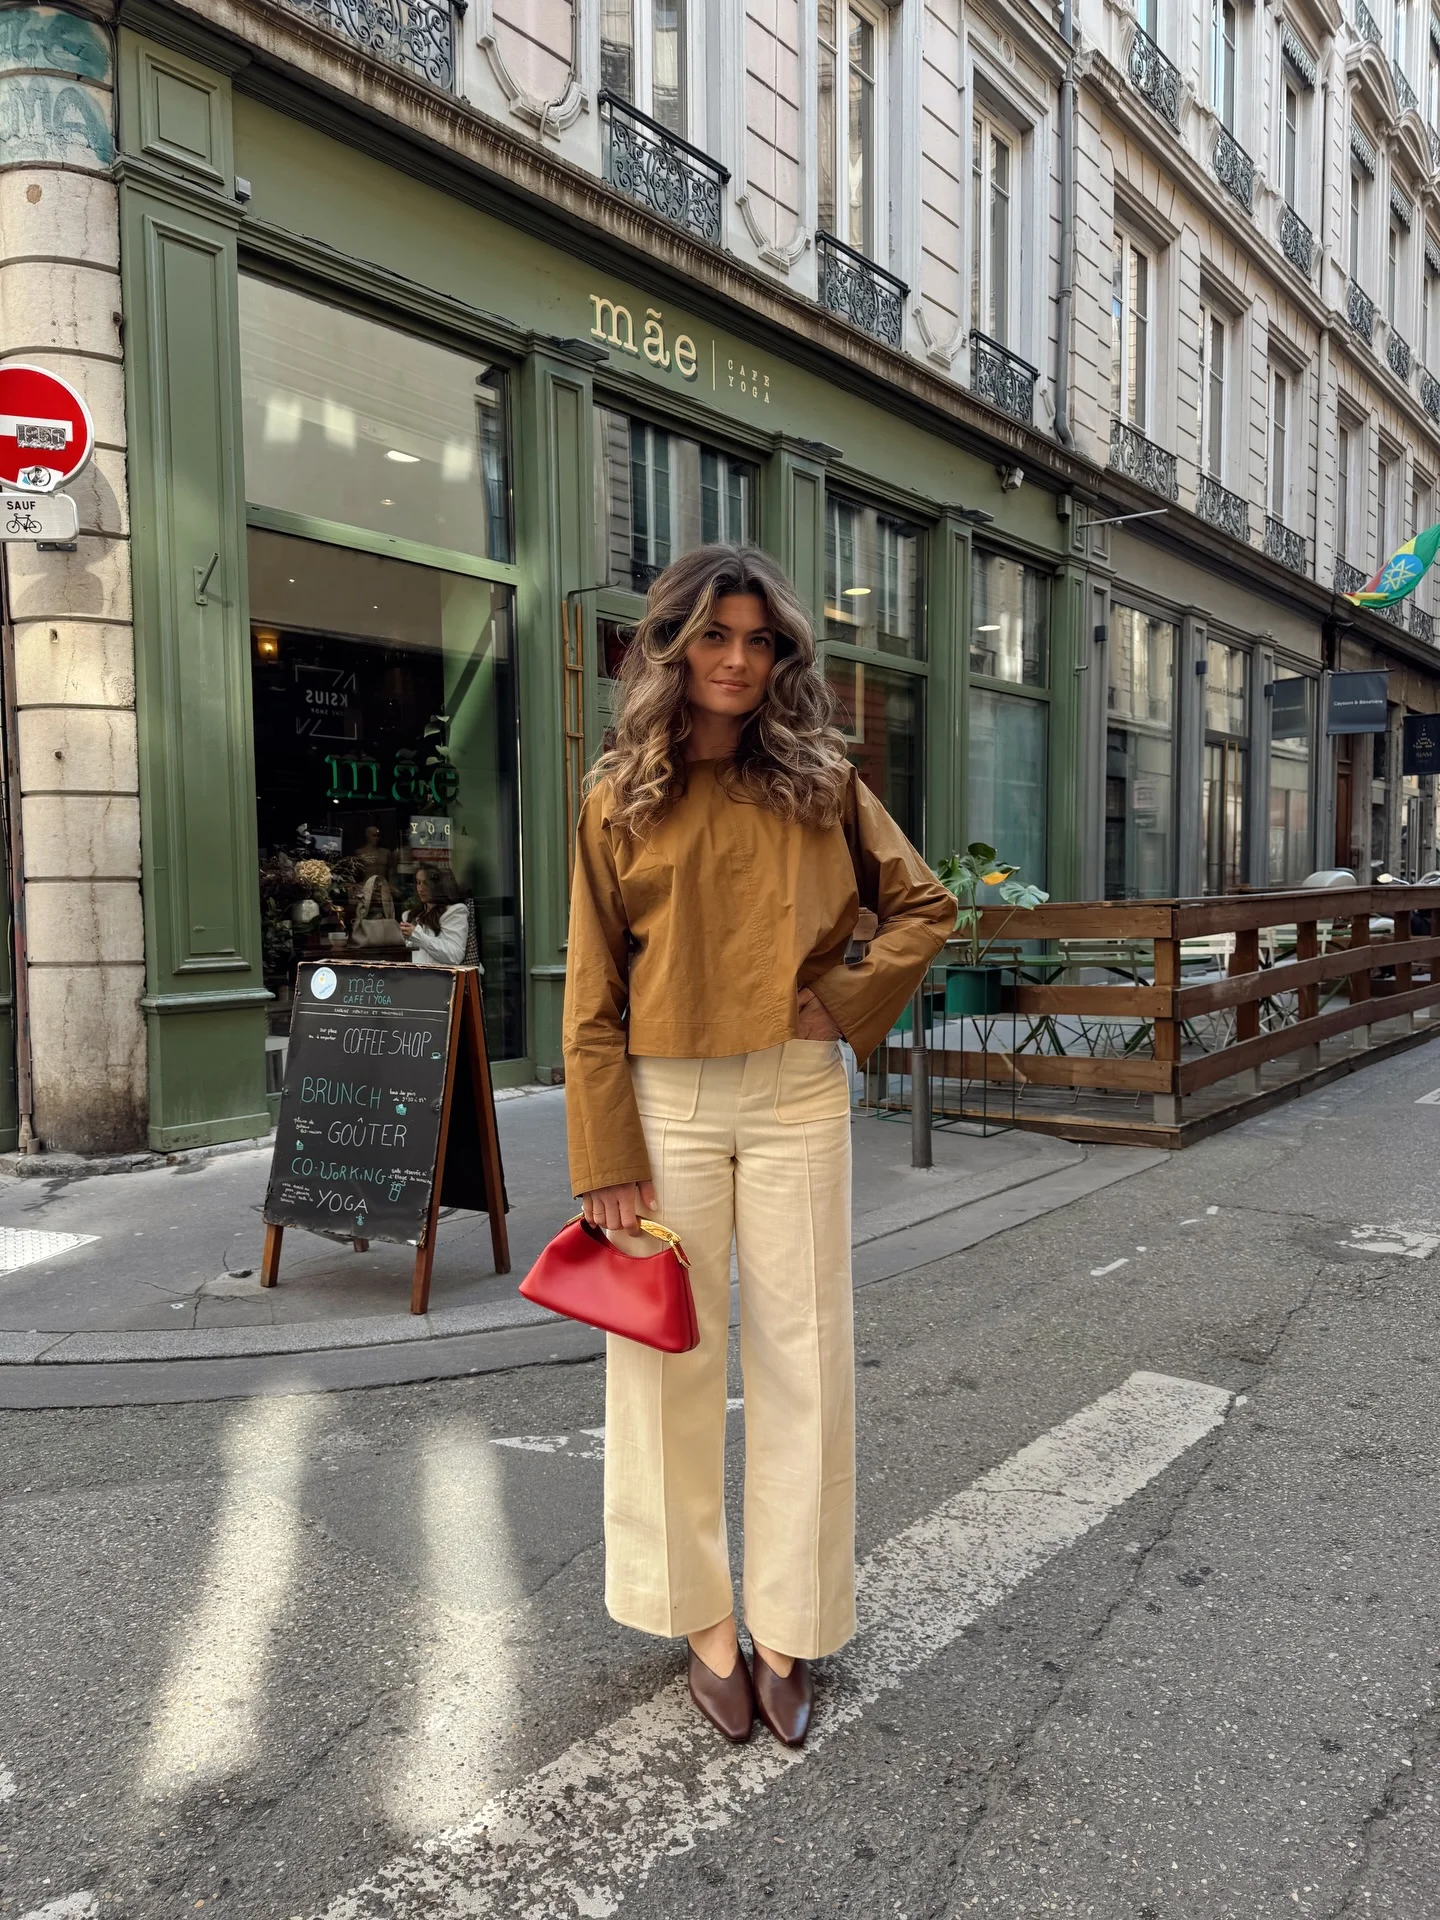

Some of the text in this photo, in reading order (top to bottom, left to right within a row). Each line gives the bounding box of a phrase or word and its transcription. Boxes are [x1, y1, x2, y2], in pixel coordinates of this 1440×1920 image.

[590, 294, 697, 378] mãe
[728, 359, 770, 388] CAFE
[728, 375, 770, 404] YOGA
[6, 500, 36, 511] SAUF
[410, 822, 469, 836] YOGA
[348, 973, 385, 994] mãe
[343, 994, 392, 1005] CAFE YOGA
[343, 1028, 432, 1058] COFFEE SHOP
[301, 1076, 382, 1110] BRUNCH
[327, 1117, 408, 1148] GOÛTER
[315, 1189, 369, 1215] YOGA
